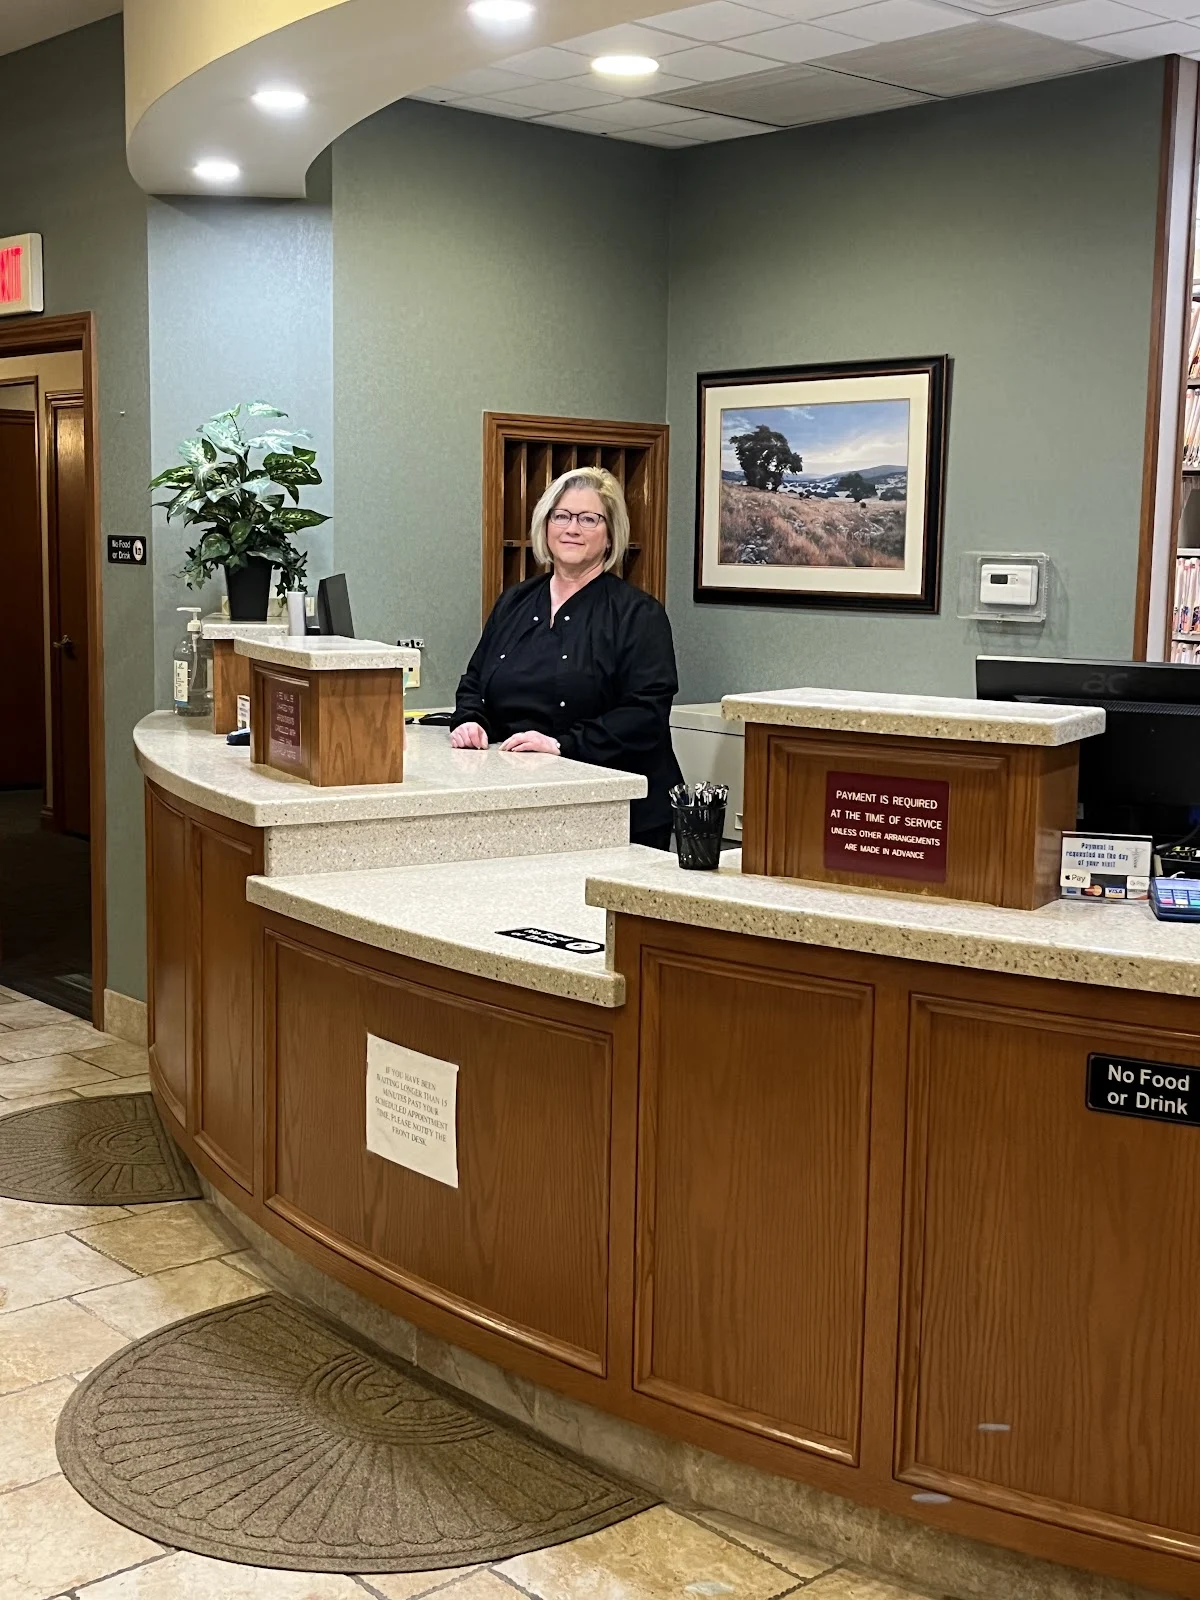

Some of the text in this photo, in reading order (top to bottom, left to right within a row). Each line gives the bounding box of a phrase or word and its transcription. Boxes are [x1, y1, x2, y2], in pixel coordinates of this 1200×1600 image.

[119, 540, 130, 548] Food
[119, 551, 130, 559] Drink
[836, 790, 938, 810] PAYMENT IS REQUIRED
[830, 809, 942, 830] AT THE TIME OF SERVICE
[831, 827, 940, 846] UNLESS OTHER ARRANGEMENTS
[1081, 842, 1106, 850] Payment
[844, 843, 857, 851] ARE
[860, 845, 880, 854] MADE
[892, 849, 924, 859] ADVANCE
[1066, 850, 1096, 859] requested
[1072, 874, 1085, 883] Pay
[392, 1068, 403, 1079] YOU
[405, 1073, 420, 1085] HAVE
[421, 1079, 436, 1091] BEEN
[1108, 1064, 1190, 1091] No Food
[383, 1088, 439, 1116] MINUTES PAST YOUR
[400, 1083, 422, 1098] LONGER
[424, 1092, 440, 1104] THAN
[441, 1099, 448, 1107] 15
[1107, 1092, 1188, 1115] or Drink
[375, 1096, 448, 1131] SCHEDULED APPOINTMENT
[391, 1113, 411, 1128] PLEASE
[413, 1122, 434, 1137] NOTIFY
[436, 1131, 446, 1142] THE
[392, 1126, 410, 1139] FRONT
